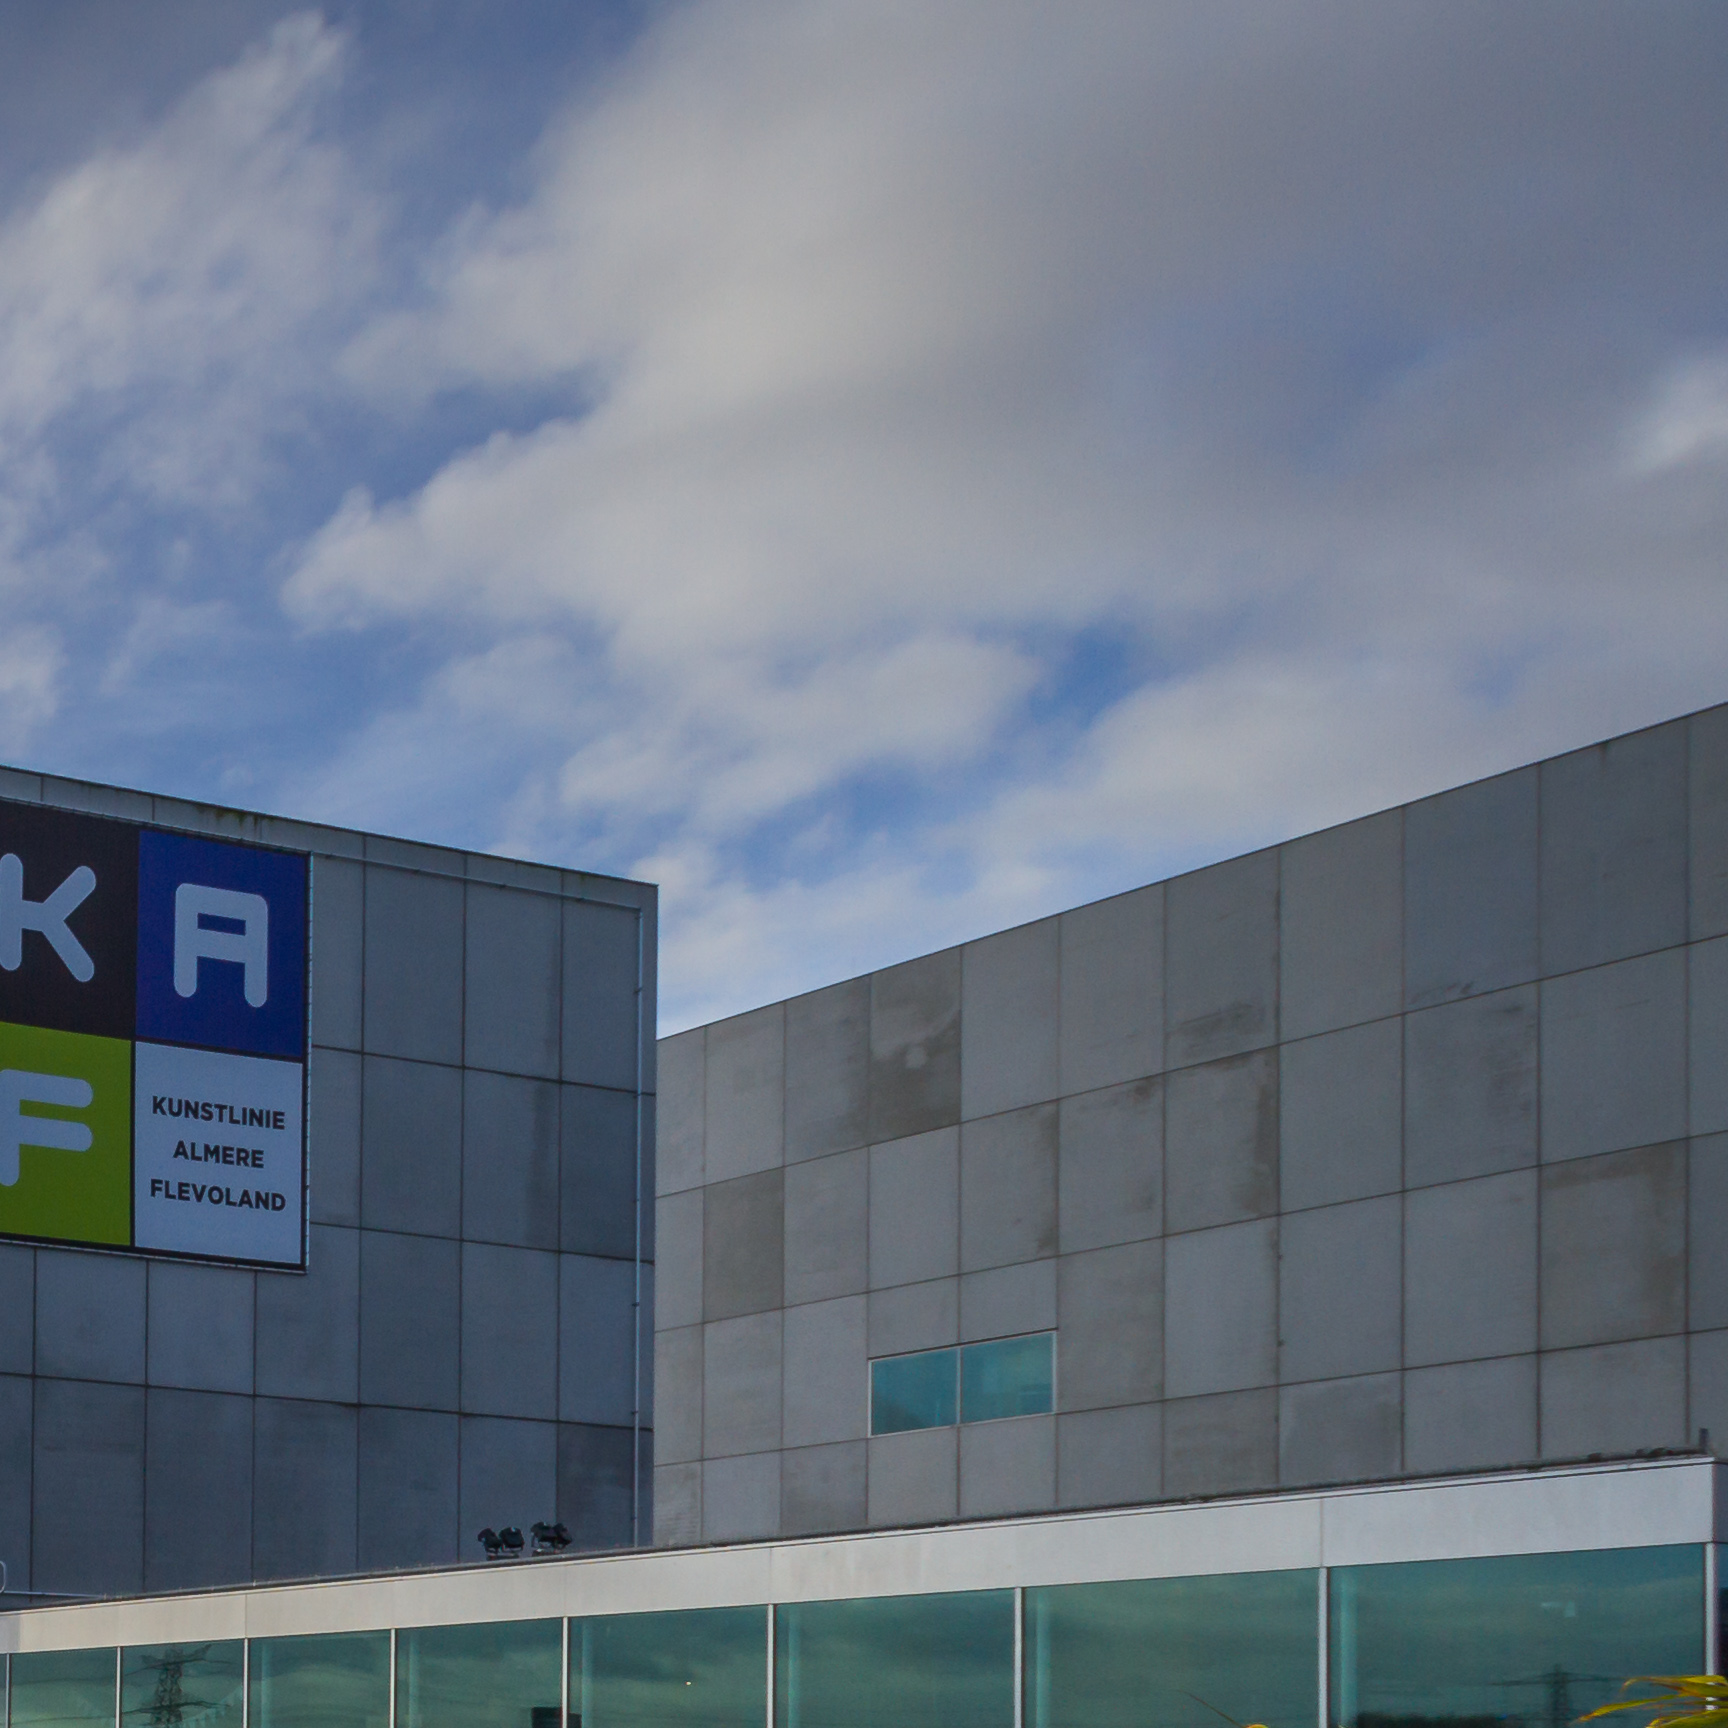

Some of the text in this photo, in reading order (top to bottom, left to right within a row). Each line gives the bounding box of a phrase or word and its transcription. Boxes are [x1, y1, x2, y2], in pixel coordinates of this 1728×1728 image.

[173, 882, 269, 1008] A
[151, 1096, 286, 1130] KUNSTLINIE
[173, 1140, 264, 1169] ALMERE
[150, 1178, 286, 1212] FLEVOLAND
